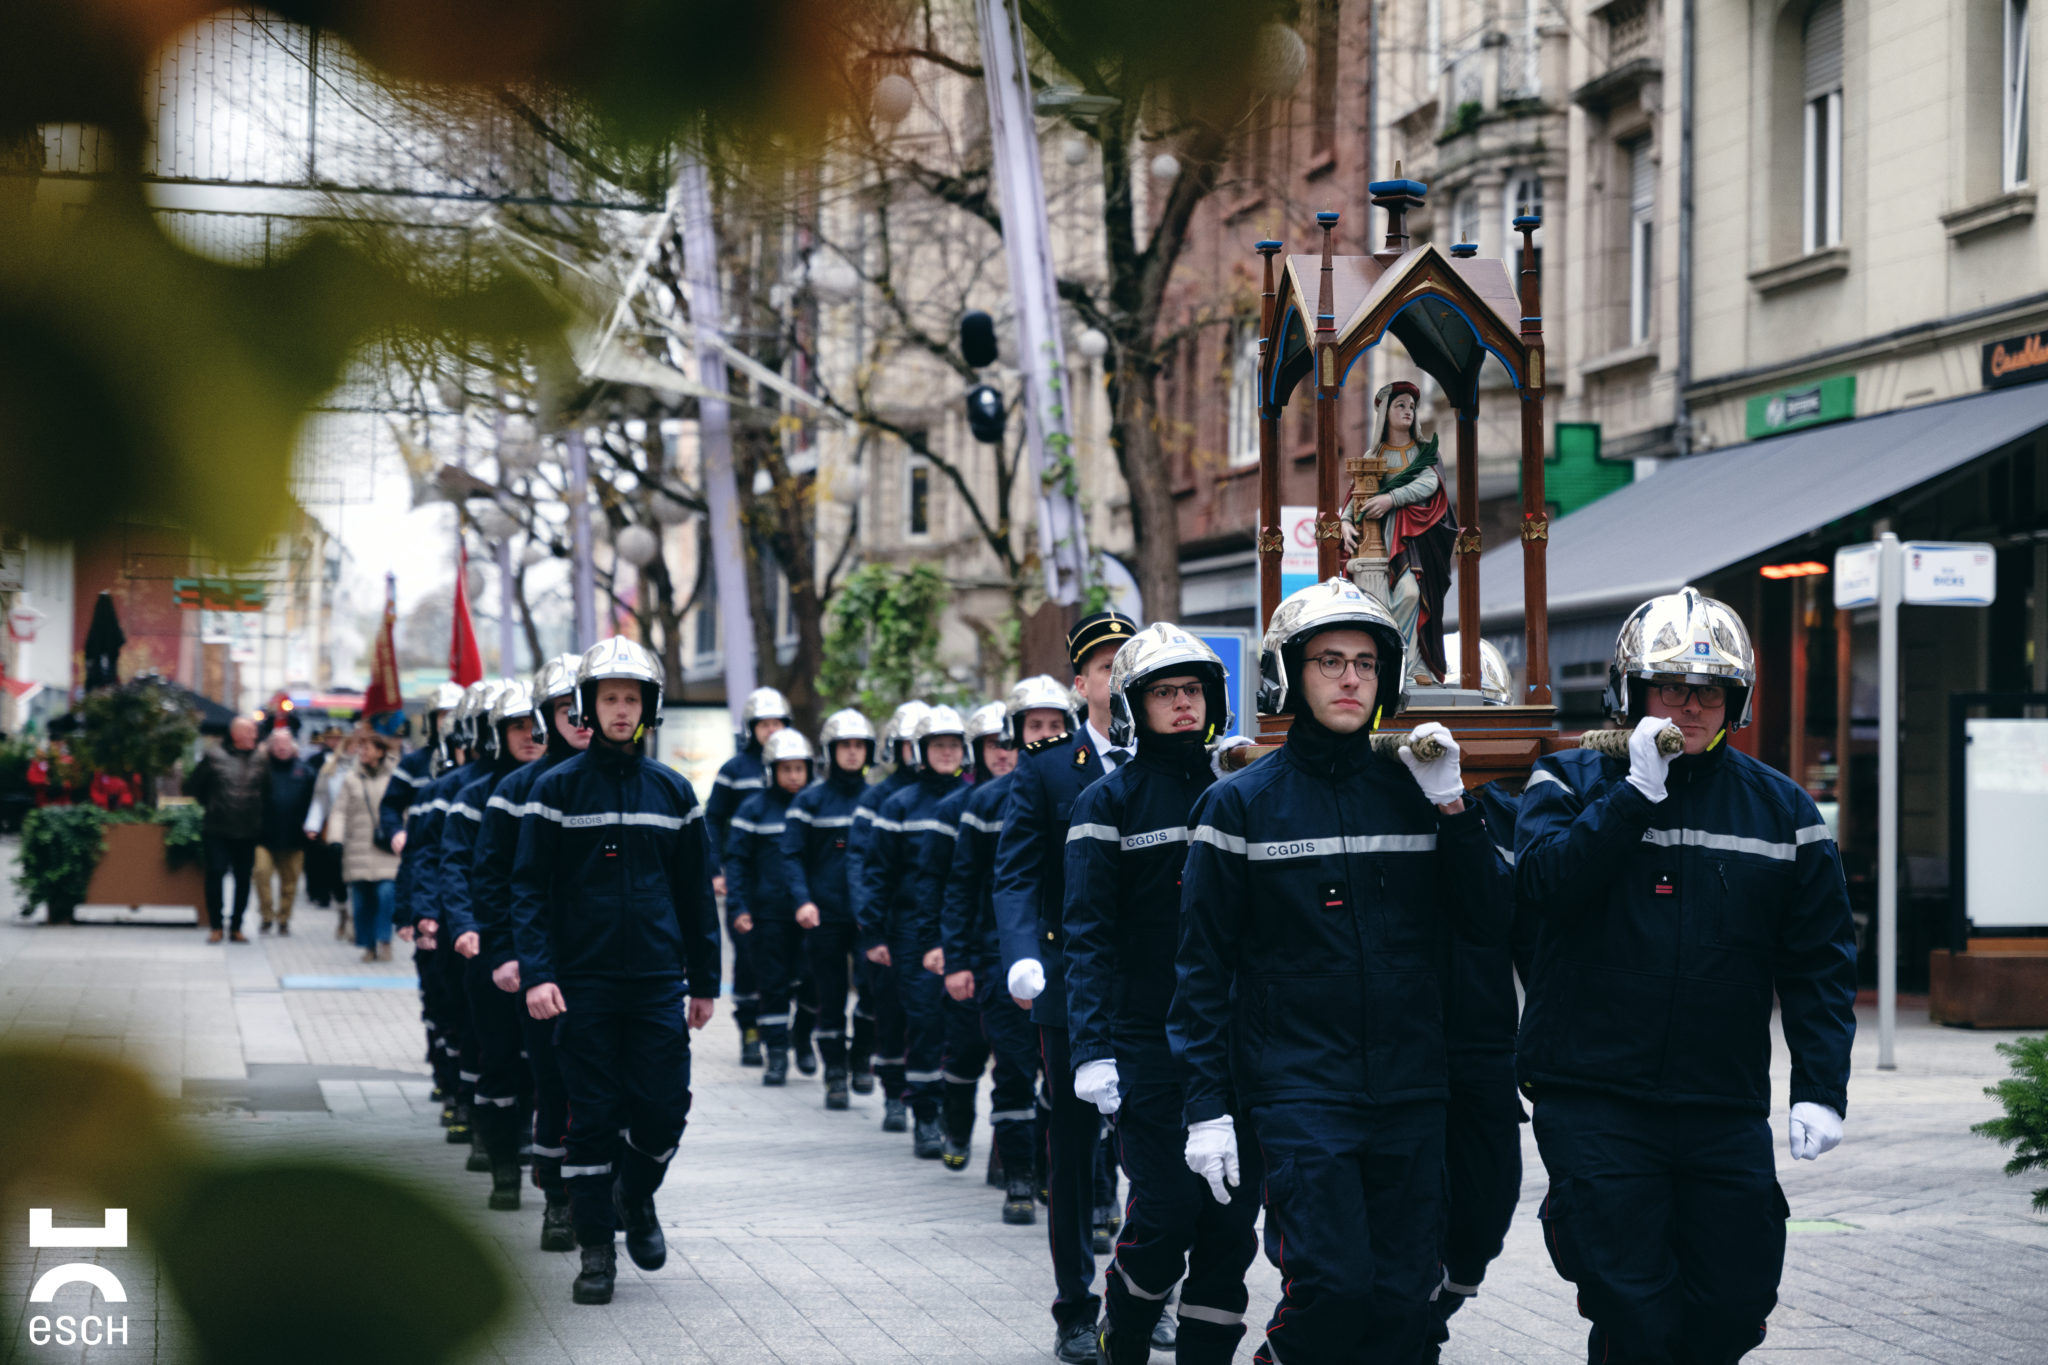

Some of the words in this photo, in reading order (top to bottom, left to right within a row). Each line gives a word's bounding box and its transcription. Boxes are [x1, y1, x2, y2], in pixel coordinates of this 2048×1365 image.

[569, 816, 602, 826] CGDIS
[1126, 831, 1168, 848] CGDIS
[1266, 842, 1316, 857] CGDIS
